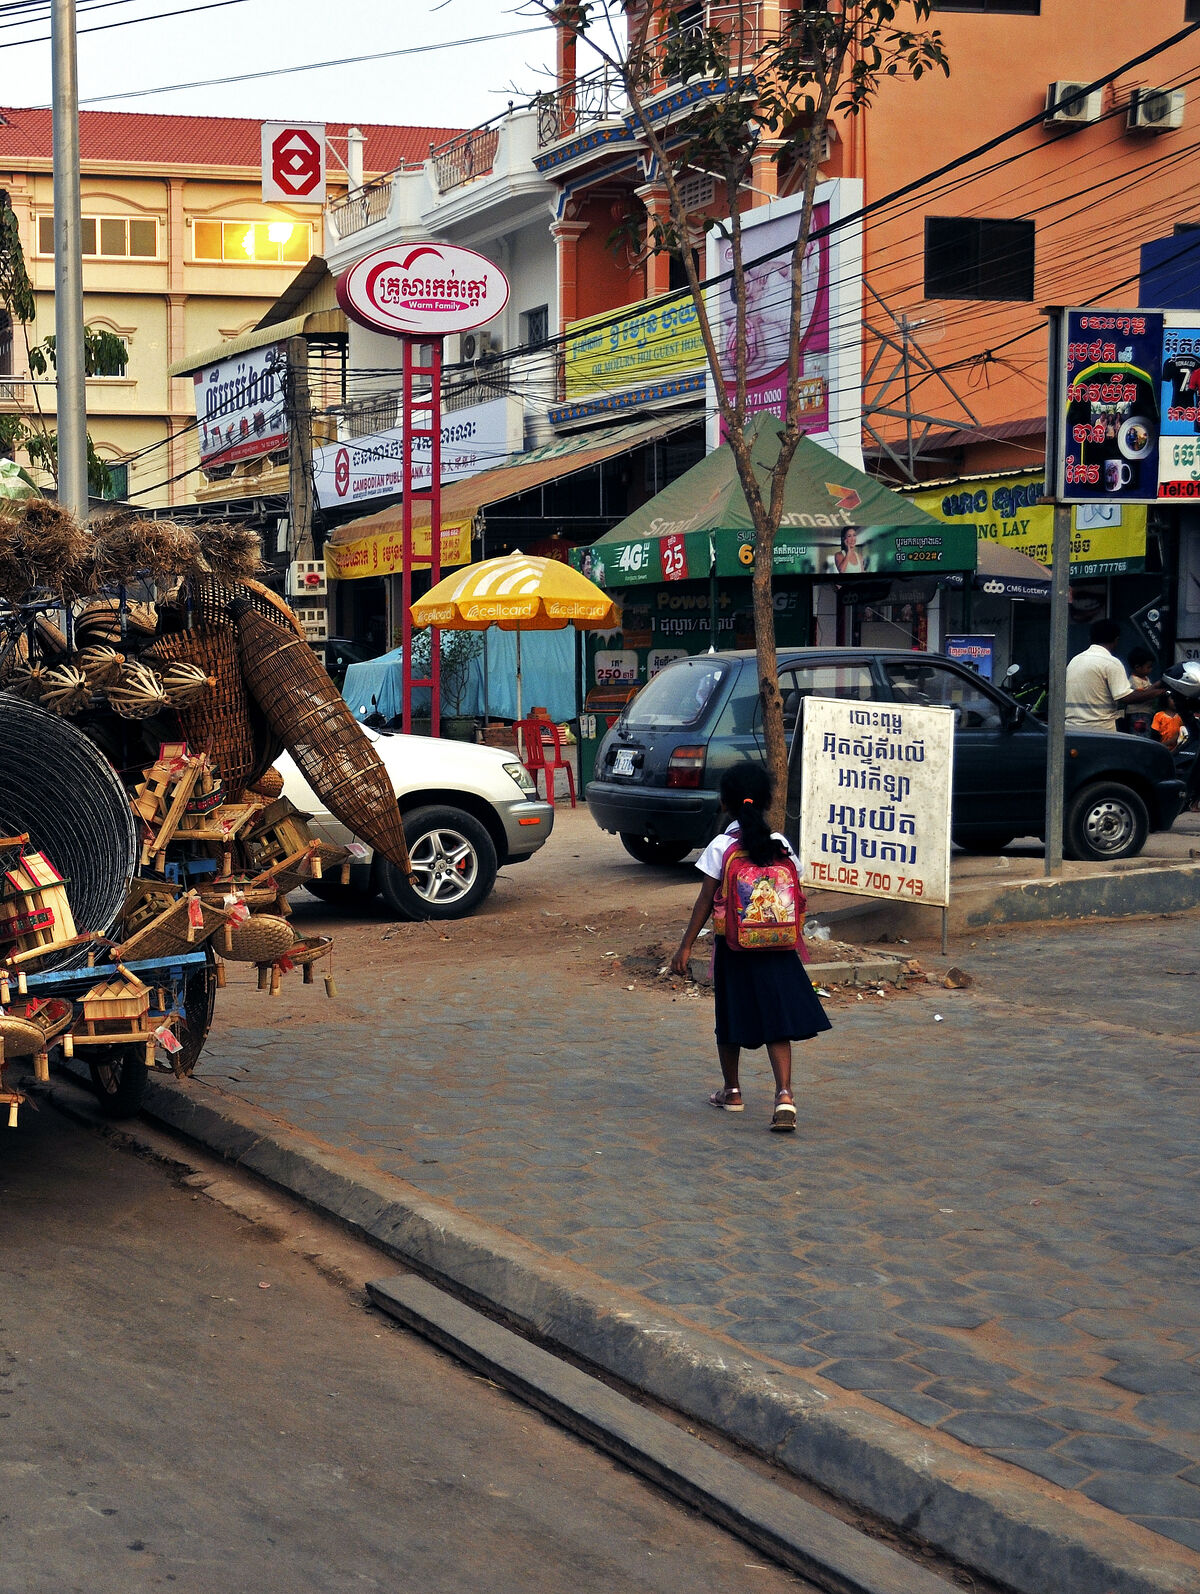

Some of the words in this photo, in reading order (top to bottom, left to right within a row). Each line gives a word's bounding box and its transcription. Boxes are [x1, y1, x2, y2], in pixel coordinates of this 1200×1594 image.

[408, 300, 433, 309] Warm
[434, 300, 461, 311] Family
[653, 342, 680, 360] GUEST
[681, 334, 704, 352] HOUS
[1179, 368, 1190, 393] 7
[764, 388, 782, 404] 0000
[352, 475, 385, 493] CAMBODIAN
[385, 469, 403, 486] PUBLI
[411, 465, 424, 479] ANK
[737, 530, 757, 541] SUP
[978, 524, 998, 539] NG
[1002, 520, 1030, 537] LAY
[620, 543, 642, 571] 4G
[642, 542, 650, 567] LTE
[664, 544, 684, 574] 25
[738, 544, 756, 565] 6
[1084, 564, 1098, 575] 097
[1006, 585, 1022, 593] CM6
[1022, 586, 1049, 595] Lottery
[422, 607, 452, 622] cellcard
[479, 603, 531, 618] cellcard
[559, 603, 604, 617] cellcard
[597, 669, 621, 679] 250
[849, 710, 902, 735] បោះពុម្ព
[865, 871, 891, 892] 700
[897, 876, 924, 897] 743
